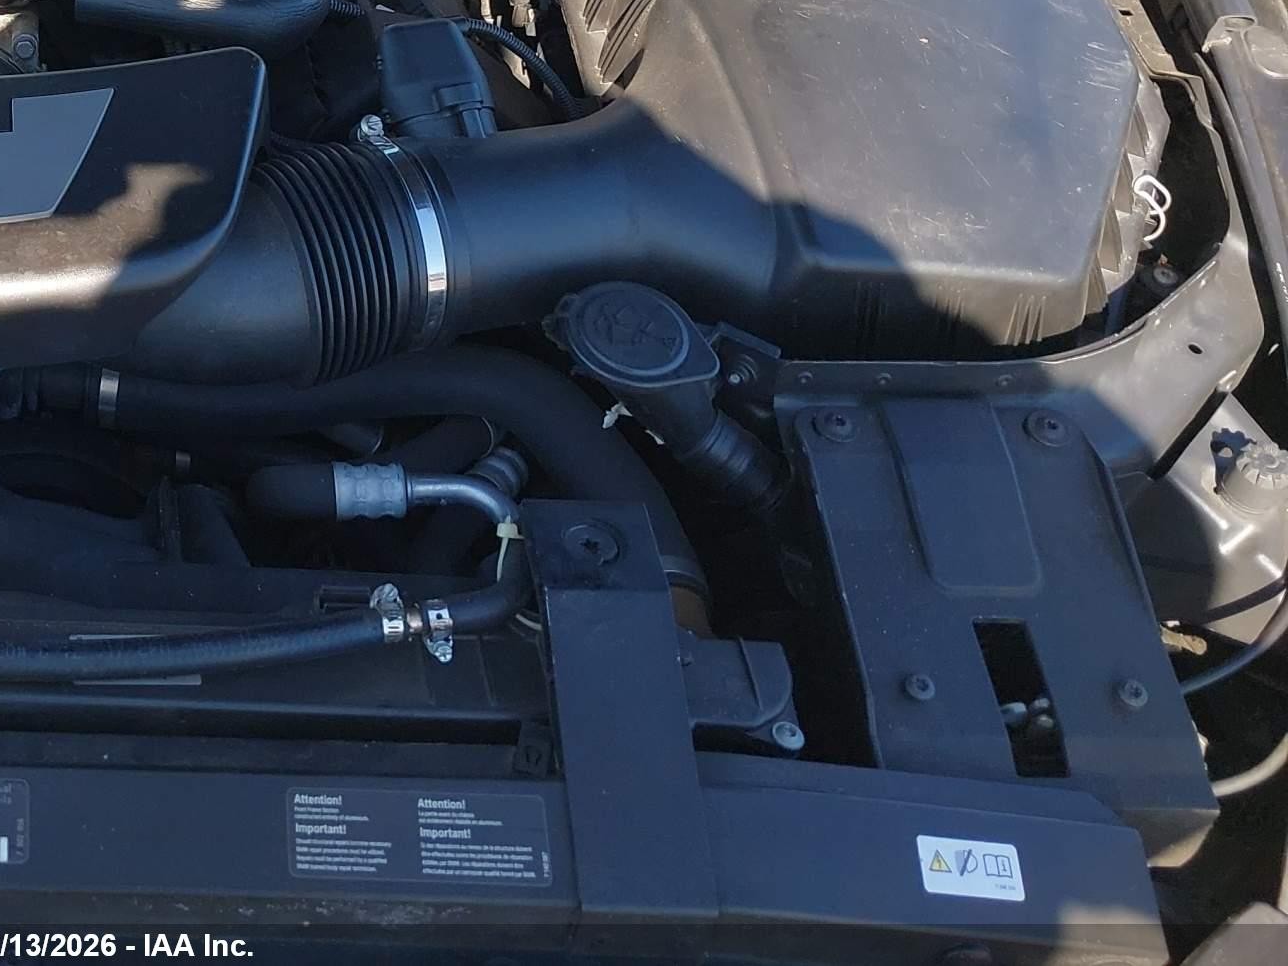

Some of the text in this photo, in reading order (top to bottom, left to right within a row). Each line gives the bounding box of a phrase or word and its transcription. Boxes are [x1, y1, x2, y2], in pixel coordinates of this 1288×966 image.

[294, 793, 342, 806] Attention!
[418, 798, 466, 811] Attention!
[295, 822, 347, 836] Important!
[419, 826, 472, 839] Important!
